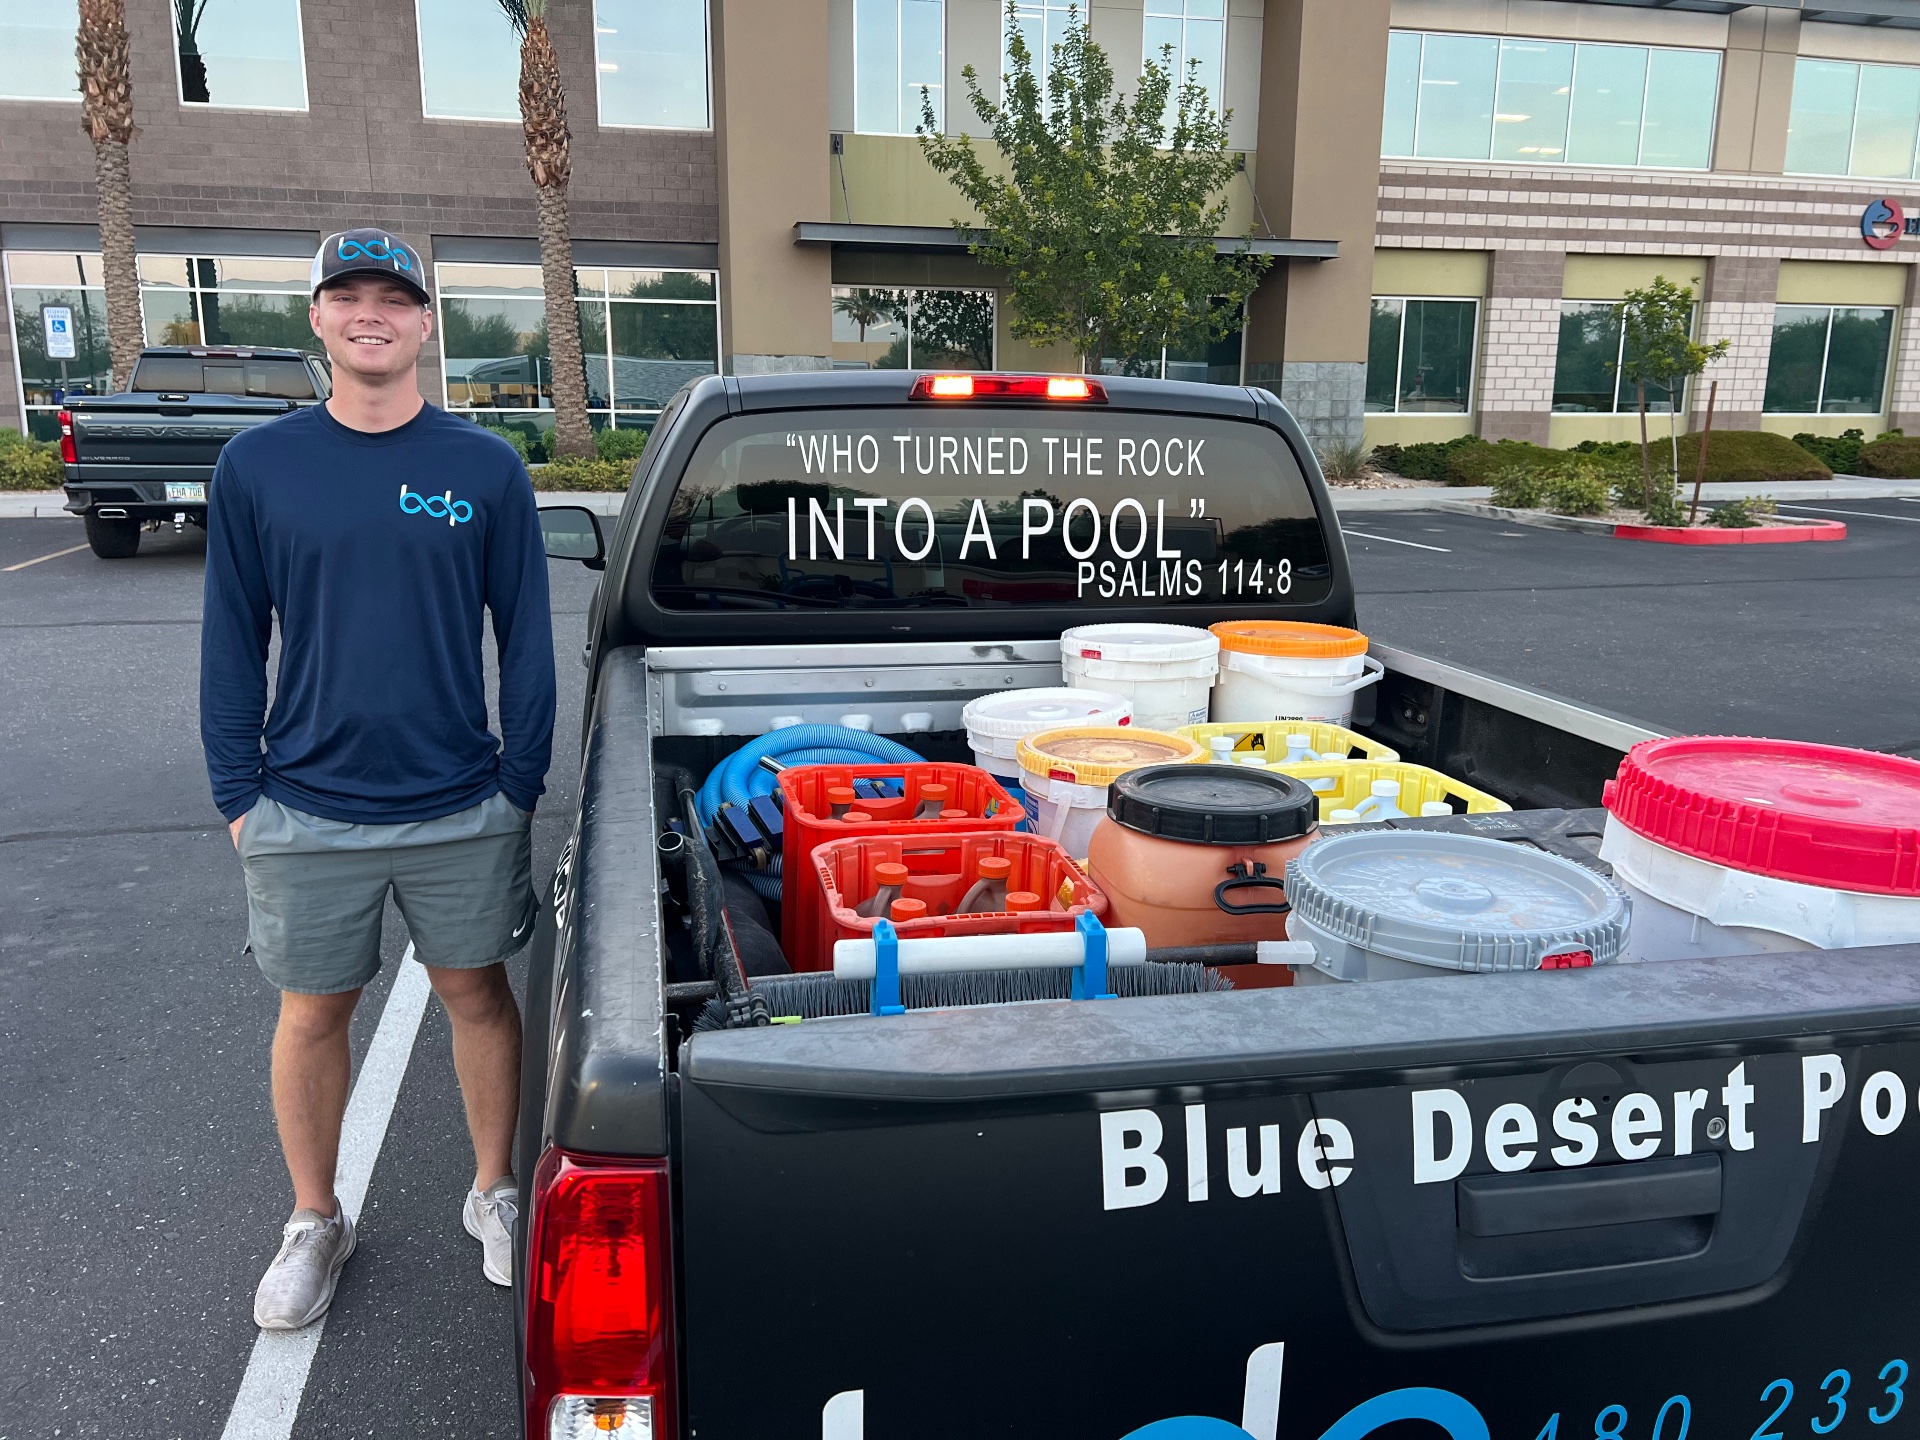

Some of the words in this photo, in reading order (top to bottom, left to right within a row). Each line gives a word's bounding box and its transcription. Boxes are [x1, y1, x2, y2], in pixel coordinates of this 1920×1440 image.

[892, 435, 1029, 475] TURNED
[1041, 437, 1103, 476] THE
[1118, 438, 1206, 477] ROCK
[788, 497, 935, 561] INTO
[959, 498, 997, 560] A
[1077, 560, 1202, 598] PSALMS
[1218, 558, 1292, 595] 114:8
[1099, 1102, 1355, 1211] Blue
[1411, 1060, 1755, 1185] Desert
[1801, 1053, 1920, 1144] Po
[1750, 1358, 1909, 1440] 233
